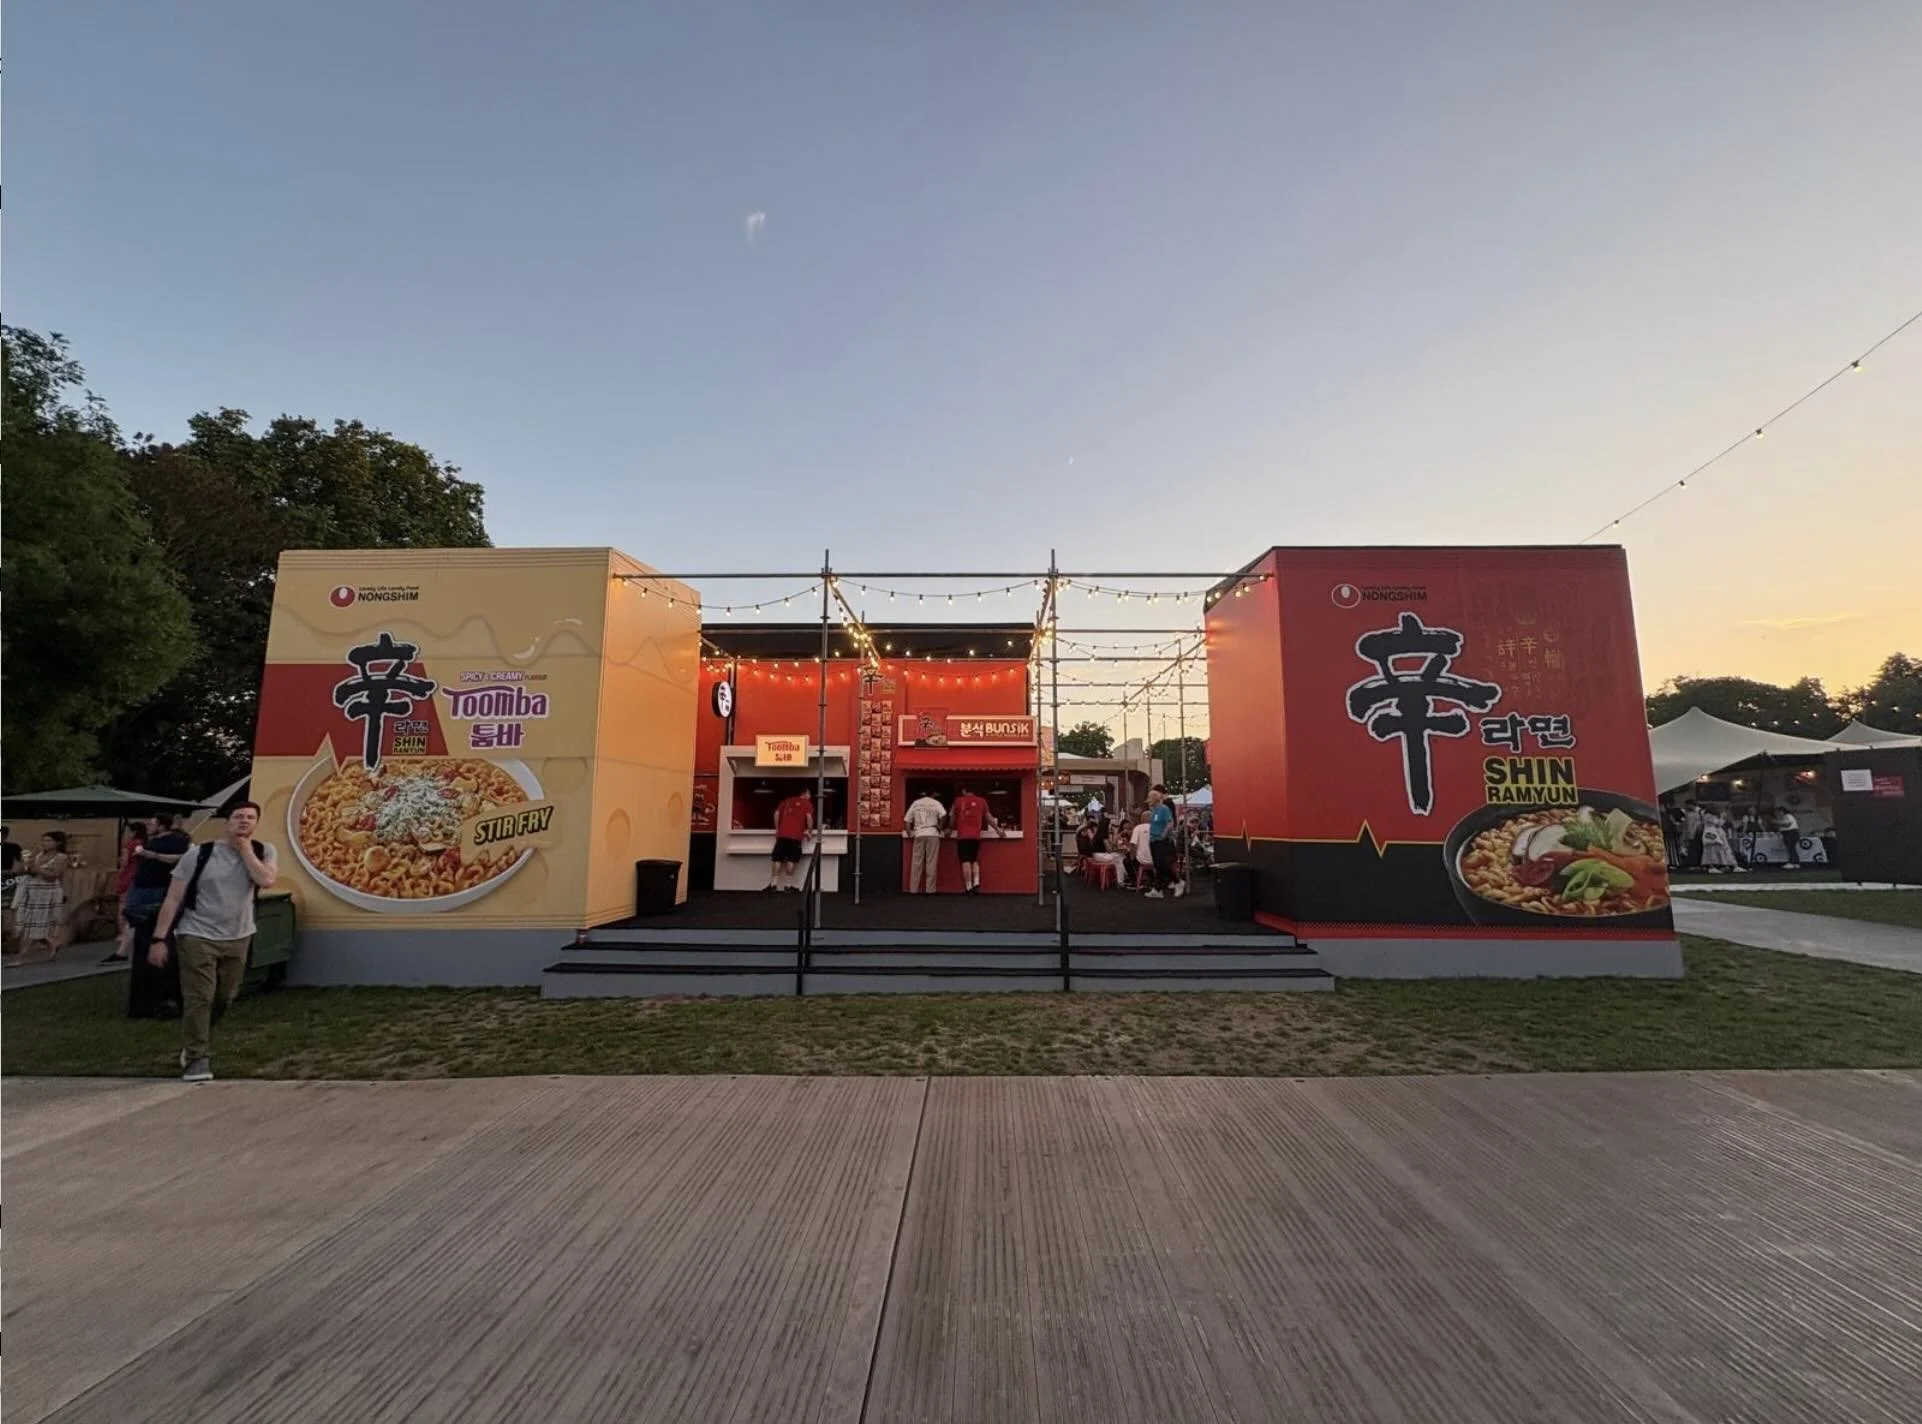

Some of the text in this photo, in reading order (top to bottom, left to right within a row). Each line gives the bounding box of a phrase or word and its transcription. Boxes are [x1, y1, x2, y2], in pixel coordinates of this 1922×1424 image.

[358, 591, 419, 602] NONGSHIM
[1361, 591, 1427, 601] NONGSHIM
[460, 672, 484, 682] SPICY
[490, 671, 524, 682] CREAMY
[333, 631, 437, 771] 辛
[442, 685, 548, 717] Toomba
[1346, 612, 1501, 816] 辛
[394, 737, 426, 747] SHIN
[470, 723, 525, 748] 툼바
[960, 722, 984, 738] 분식
[1480, 712, 1576, 753] 라면
[1484, 757, 1575, 785] SHIN
[1487, 785, 1577, 803] RAMYUN
[473, 806, 554, 846] STIR FRY
